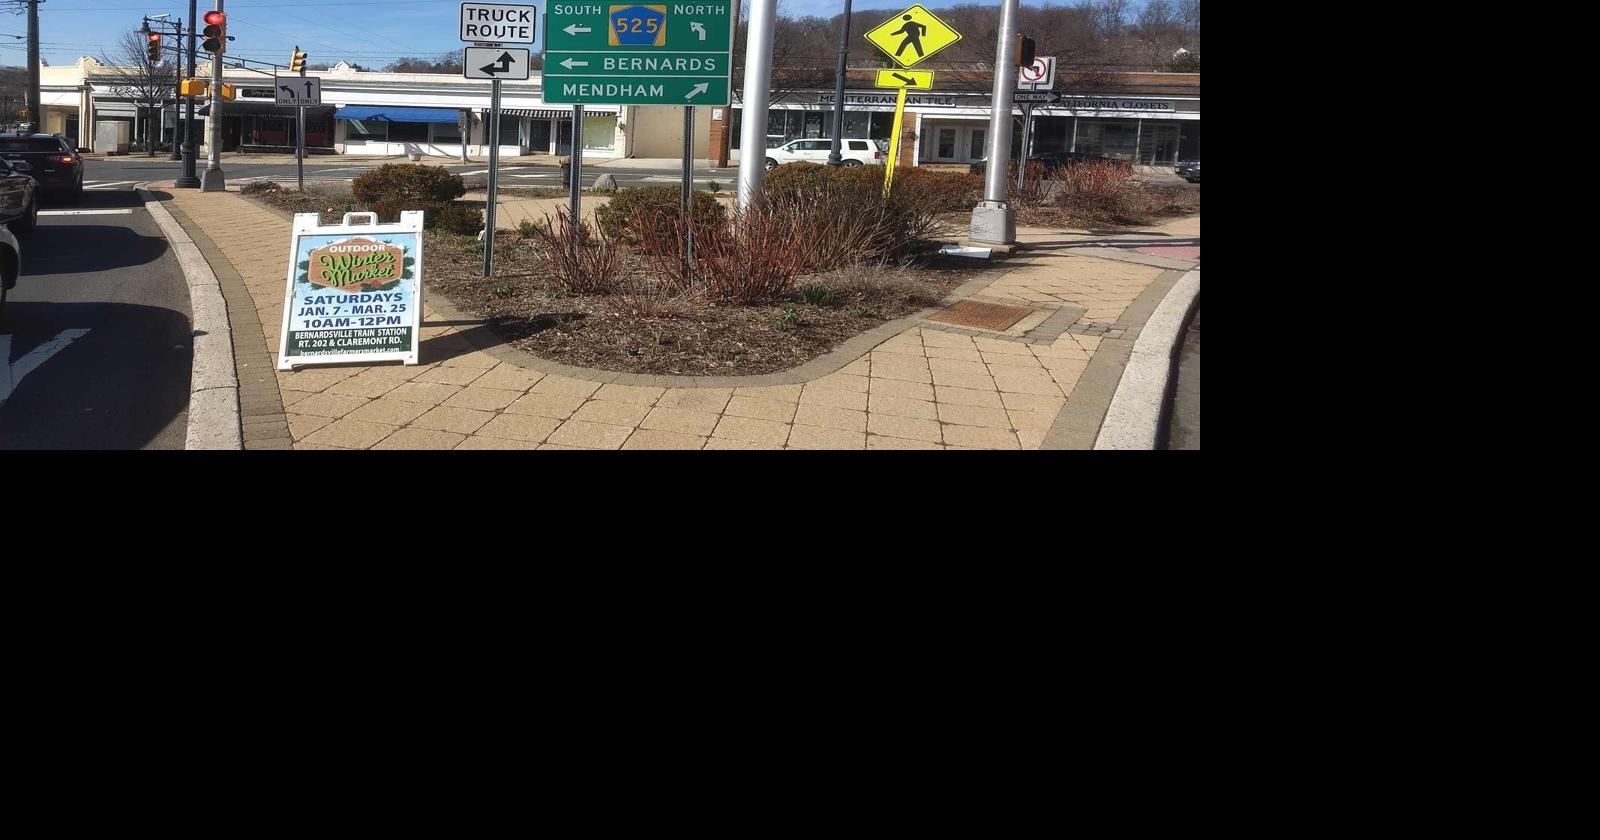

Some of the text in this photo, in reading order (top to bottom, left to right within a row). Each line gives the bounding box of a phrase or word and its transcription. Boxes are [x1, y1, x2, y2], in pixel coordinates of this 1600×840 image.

[466, 7, 530, 23] TRUCK
[554, 4, 601, 15] SOUTH
[674, 4, 725, 15] NORTH
[466, 24, 529, 39] ROUTE
[616, 18, 658, 33] 525
[603, 57, 716, 71] BERNARDS
[563, 84, 664, 97] MENDHAM
[820, 95, 921, 104] MEITERRANAN
[1053, 101, 1169, 110] ALIFORNIA CLOSETS
[329, 244, 386, 253] OUTDOOR
[319, 251, 396, 271] Winter
[321, 264, 395, 287] Market
[304, 293, 403, 305] SATURDAYS
[298, 307, 329, 316] JAN.
[333, 306, 341, 315] 7
[352, 305, 387, 314] MAR.
[390, 303, 406, 313] 25
[303, 316, 401, 328] 10AM-12PM
[295, 328, 407, 339] BERNARDSVILLE TRAIN STATION
[298, 336, 402, 348] RT. 202 & CLAREMONT RD.
